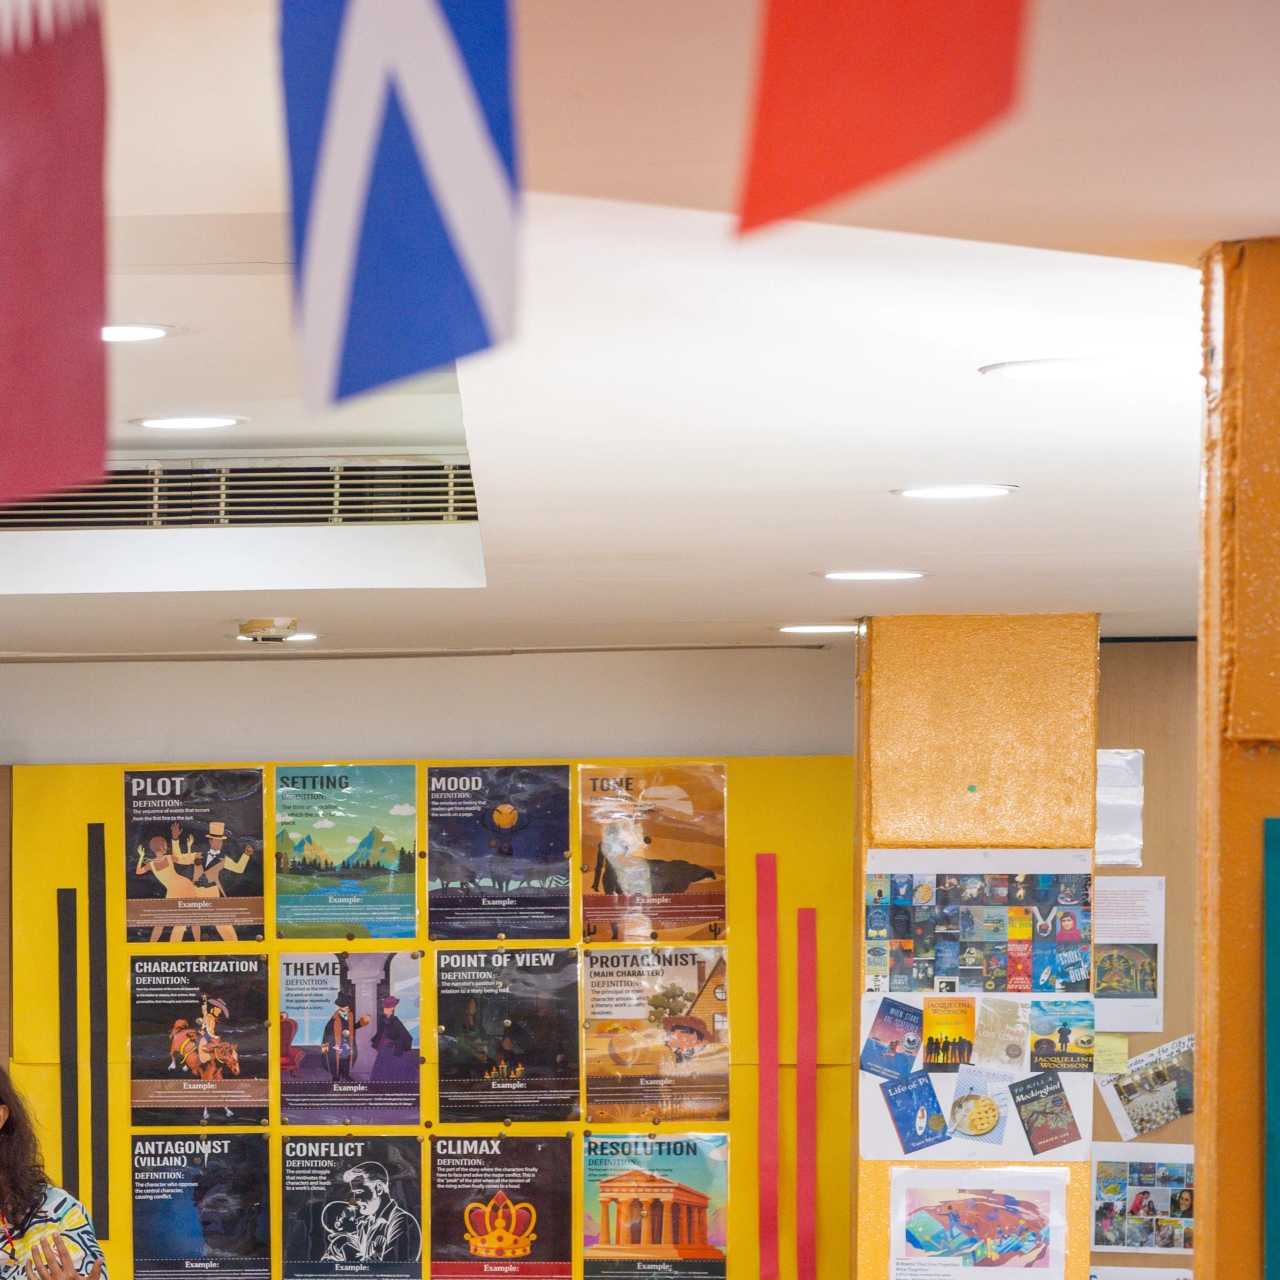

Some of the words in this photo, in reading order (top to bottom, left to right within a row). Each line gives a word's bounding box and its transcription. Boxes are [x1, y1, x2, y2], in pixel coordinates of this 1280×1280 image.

[132, 778, 184, 796] PLOT
[280, 776, 349, 790] SETTING
[431, 776, 482, 791] MOOD
[590, 777, 633, 792] TONE
[133, 800, 182, 808] DEFINITION:
[178, 901, 212, 909] Example:
[135, 961, 258, 973] CHARACTERIZATION
[441, 953, 487, 968] POINT
[492, 954, 511, 967] OF
[516, 953, 555, 967] VIEW
[590, 953, 698, 968] PROTAGONIST
[283, 962, 340, 976] THEME
[590, 970, 614, 978] (MAIN
[616, 969, 664, 977] CHARACTER)
[334, 1084, 367, 1092] Example:
[888, 1085, 906, 1096] Life
[908, 1083, 917, 1091] of
[918, 1077, 928, 1088] Pi
[1014, 1086, 1023, 1094] TO
[1025, 1081, 1044, 1090] KILL
[1015, 1082, 1060, 1103] Mockingbird
[135, 1141, 230, 1154] ANTAGONIST
[286, 1142, 364, 1157] CONFLICT
[437, 1140, 501, 1155] CLIMAX
[588, 1141, 697, 1156] RESOLUTION
[135, 1156, 187, 1167] (VILLAIN)
[135, 1172, 184, 1180] DEFINITION:
